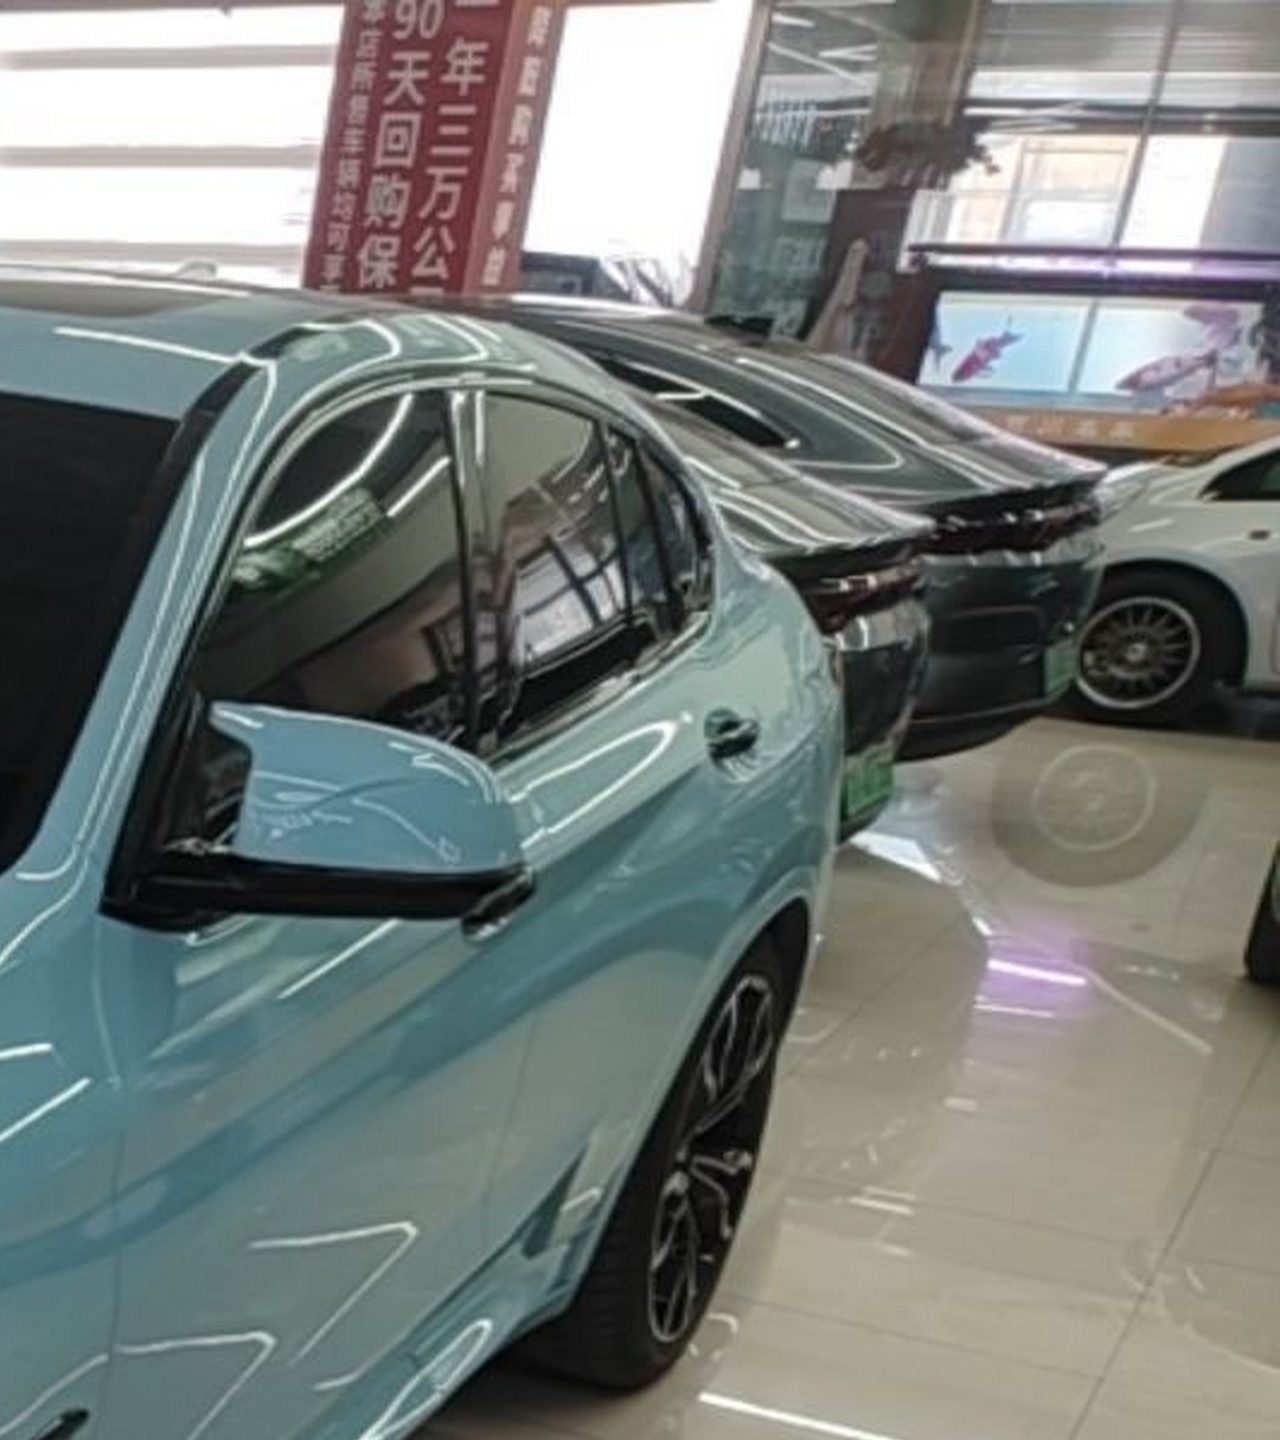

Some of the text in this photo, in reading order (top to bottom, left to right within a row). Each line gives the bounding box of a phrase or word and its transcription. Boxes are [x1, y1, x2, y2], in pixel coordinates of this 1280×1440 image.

[409, 0, 497, 295] 一年三万公
